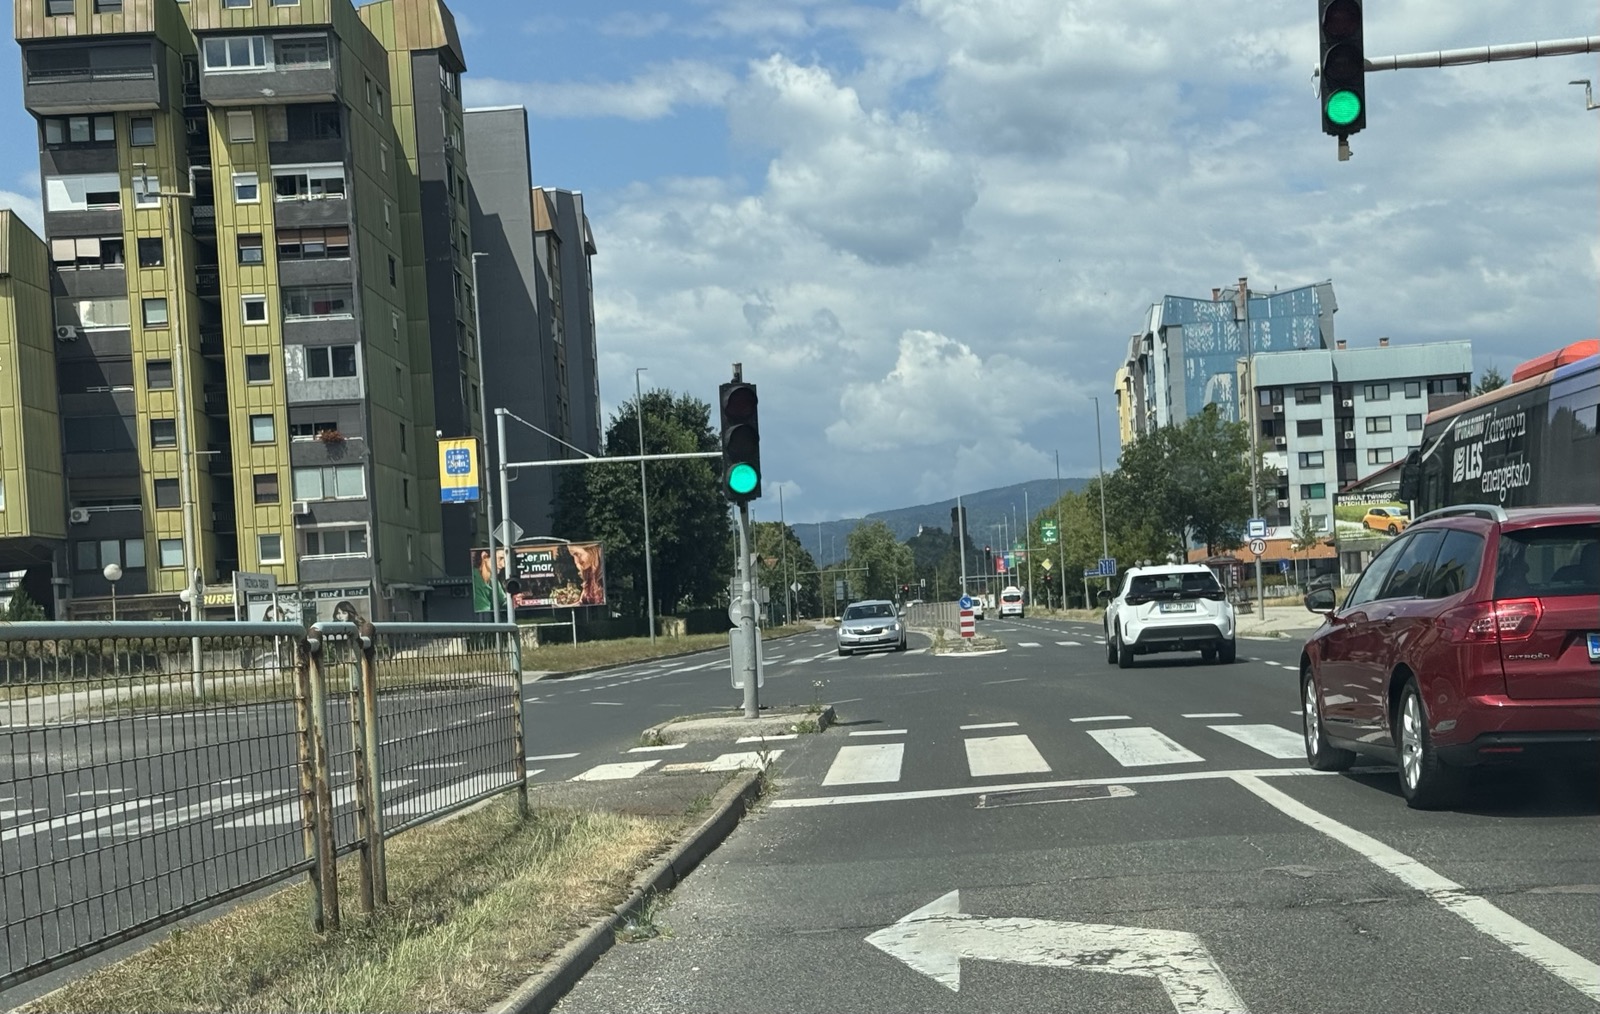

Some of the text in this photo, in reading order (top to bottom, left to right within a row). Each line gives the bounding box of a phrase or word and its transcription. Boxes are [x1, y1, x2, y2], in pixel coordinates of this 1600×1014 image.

[1484, 404, 1526, 445] Zdravo in
[1465, 441, 1483, 480] LES
[1481, 454, 1531, 502] energetsko
[1337, 494, 1366, 502] RENAULT
[539, 551, 552, 561] mi
[1252, 542, 1264, 551] 70
